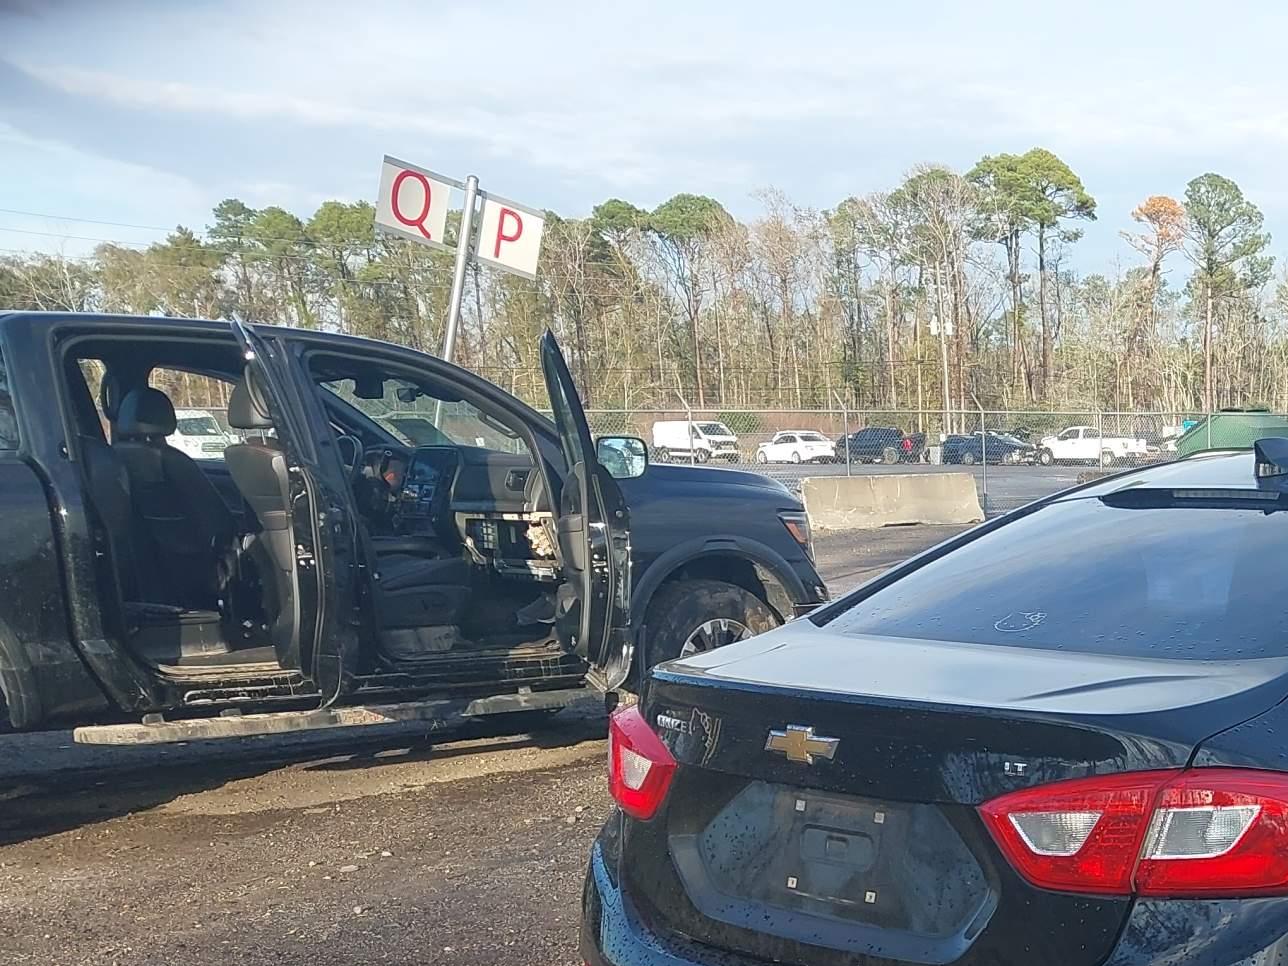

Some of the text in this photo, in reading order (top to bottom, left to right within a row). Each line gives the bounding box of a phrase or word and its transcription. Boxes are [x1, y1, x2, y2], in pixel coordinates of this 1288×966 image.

[391, 169, 431, 239] Q
[494, 207, 523, 258] P
[1004, 761, 1027, 776] LT
